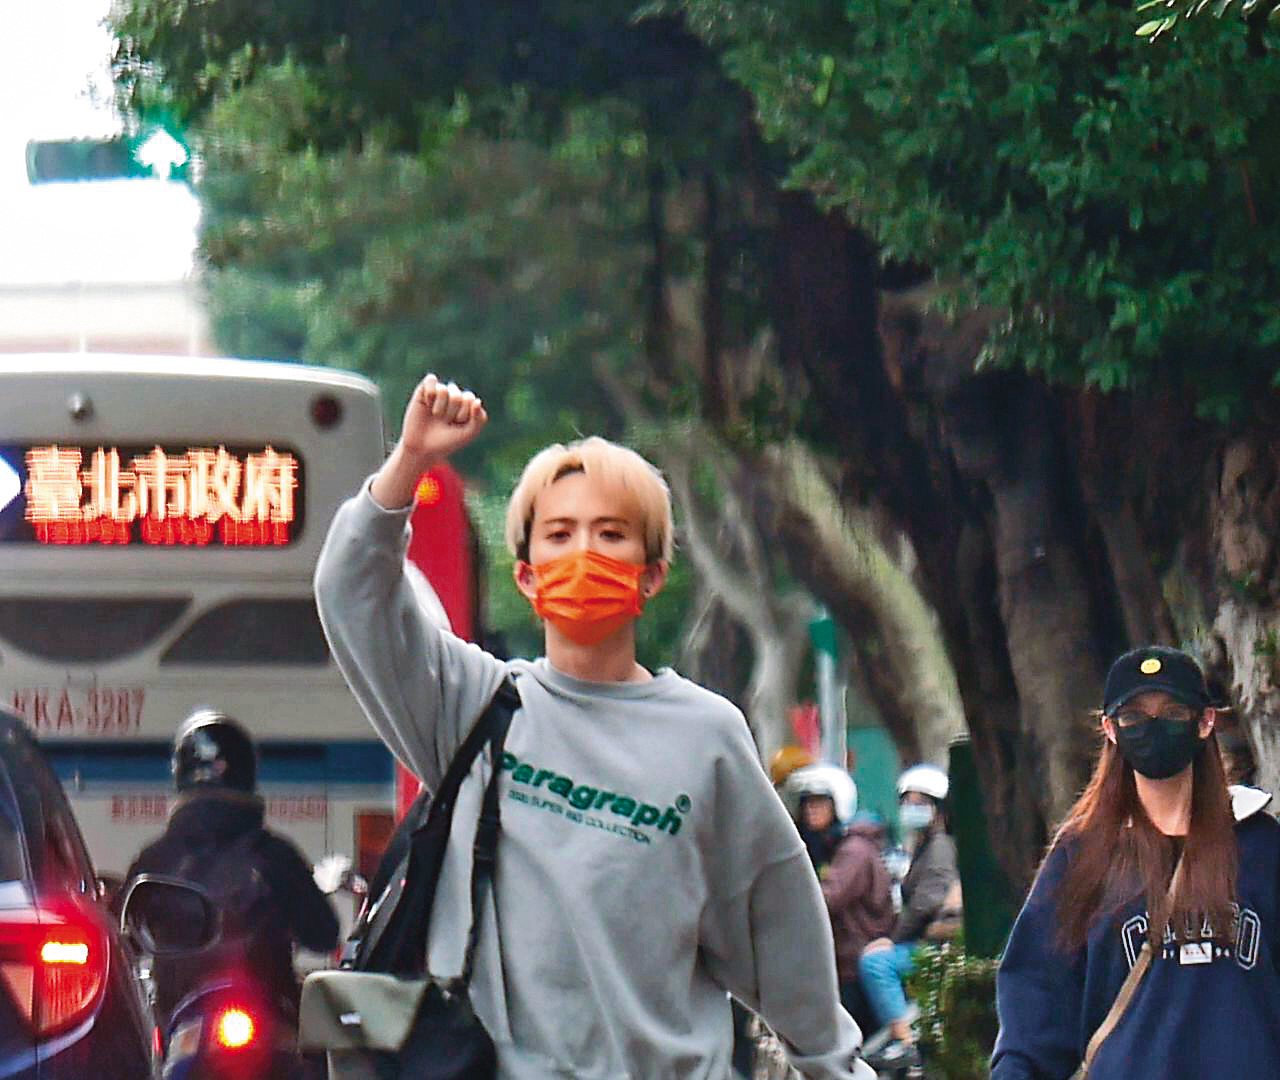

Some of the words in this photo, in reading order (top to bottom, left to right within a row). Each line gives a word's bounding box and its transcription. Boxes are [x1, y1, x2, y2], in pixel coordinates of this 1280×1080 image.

[25, 445, 298, 522] 臺北市政府
